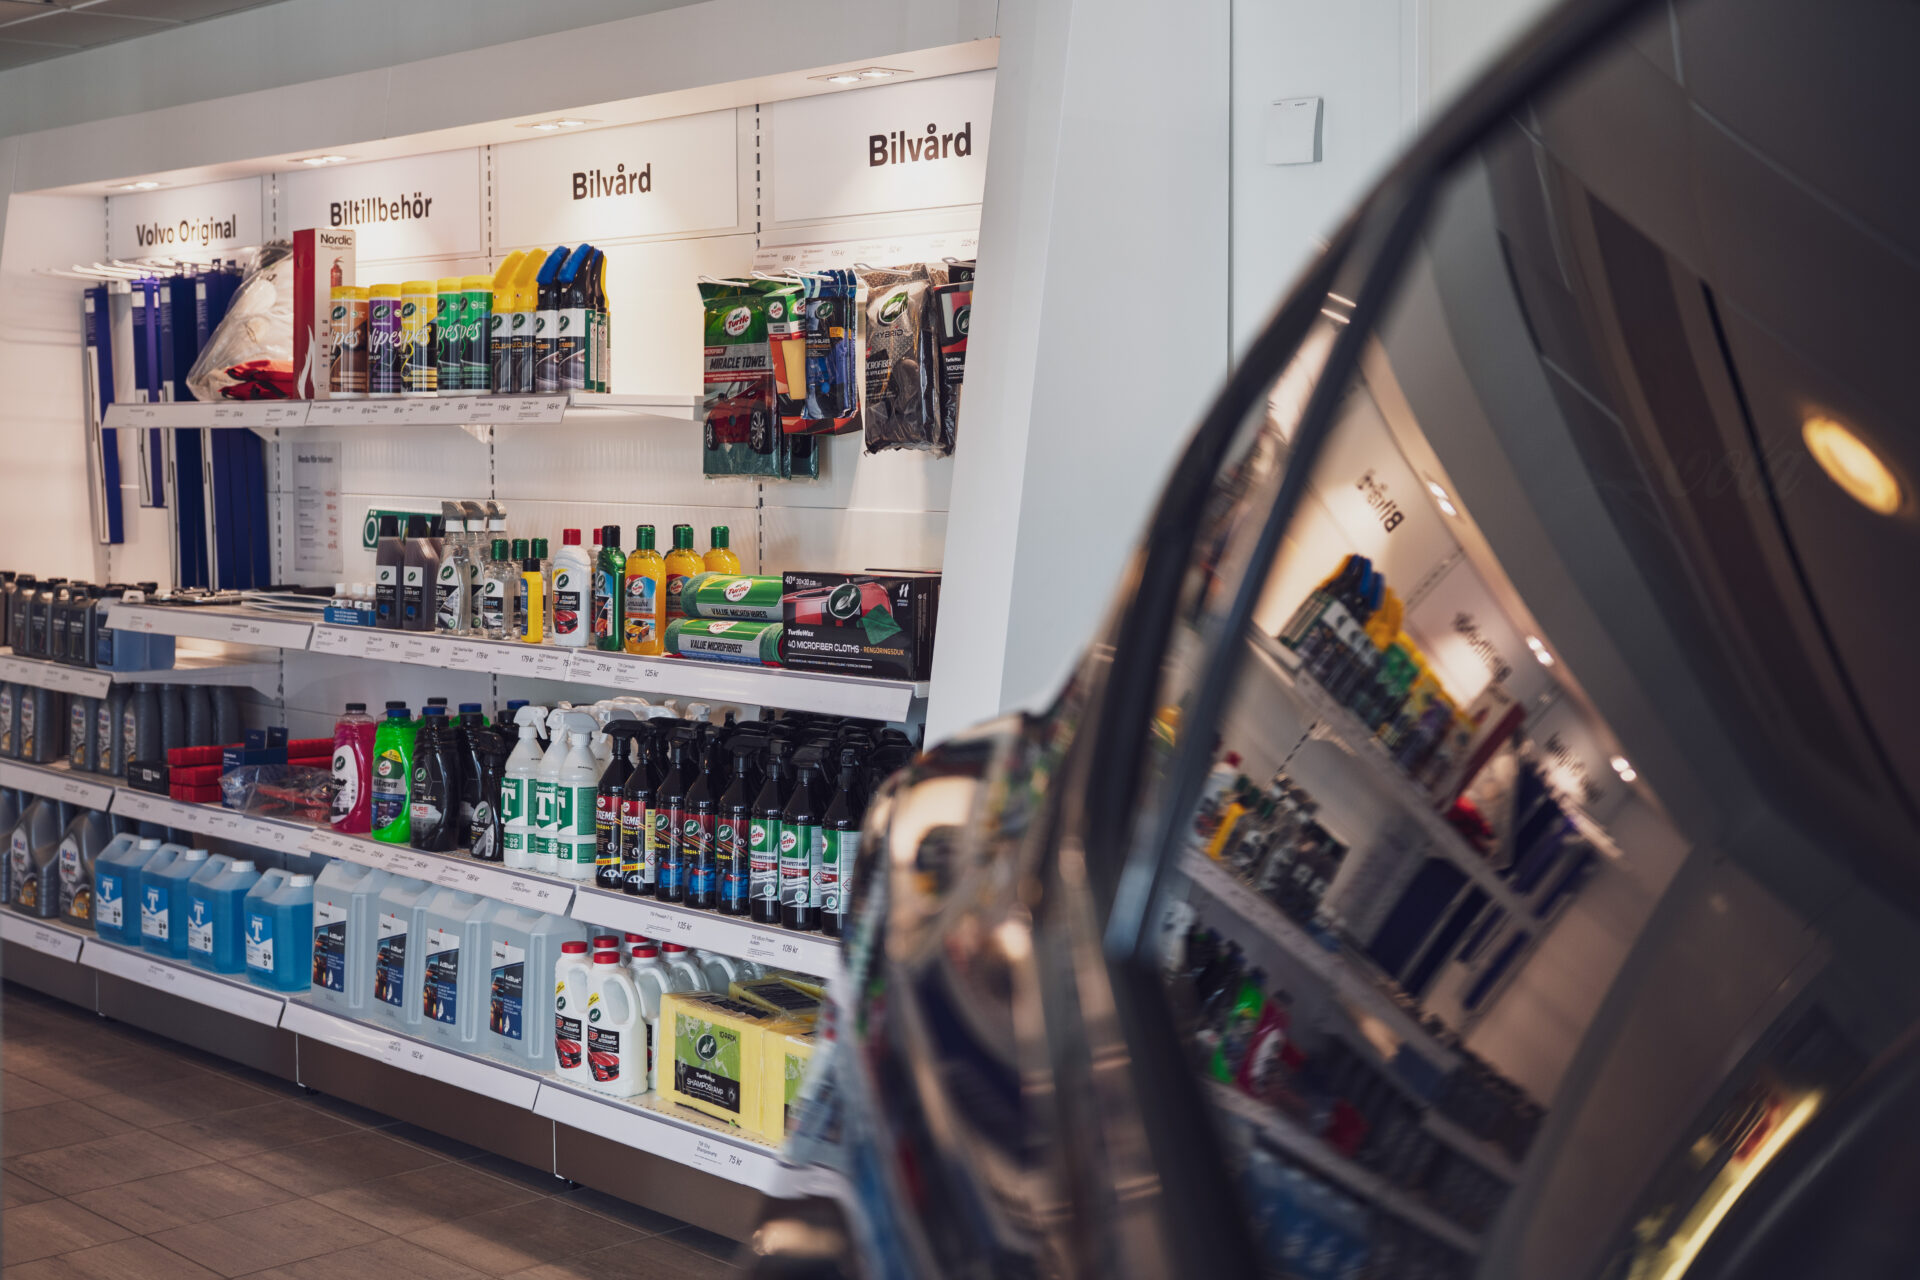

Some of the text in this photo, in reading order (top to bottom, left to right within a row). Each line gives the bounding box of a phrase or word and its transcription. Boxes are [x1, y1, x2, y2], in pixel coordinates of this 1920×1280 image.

[869, 123, 972, 167] Bilvård
[572, 163, 652, 200] Bilvård
[330, 192, 432, 227] Biltillbehör
[136, 214, 237, 246] Volvo Original
[320, 233, 352, 246] Nordic
[727, 317, 750, 329] Turtle
[874, 327, 904, 338] HYBRID
[330, 329, 359, 354] ipes
[709, 355, 766, 370] MIRACLE TOWEL
[867, 359, 892, 370] CROFIBER
[711, 608, 768, 618] VALUE MICROFIBRES
[787, 629, 814, 637] TurtleWax
[690, 639, 743, 654] VALUE MICROFIBRES
[787, 640, 796, 649] 40
[796, 640, 834, 652] MICROFIBER
[834, 644, 860, 654] CLOTHS
[521, 655, 529, 663] 179
[644, 669, 659, 678] 125 kr
[535, 792, 555, 821] T
[596, 811, 616, 821] TREME
[622, 815, 640, 825] REME
[750, 831, 764, 839] urtle
[13, 838, 26, 850] Mobil
[781, 837, 795, 846] urtle
[61, 848, 76, 862] Mobil
[102, 880, 114, 901] T
[147, 891, 159, 913] T
[193, 904, 204, 925] T
[251, 920, 263, 942] T
[677, 921, 693, 931] 135 kr
[782, 943, 799, 954] 109 kr
[728, 1154, 743, 1166] 75 kr
